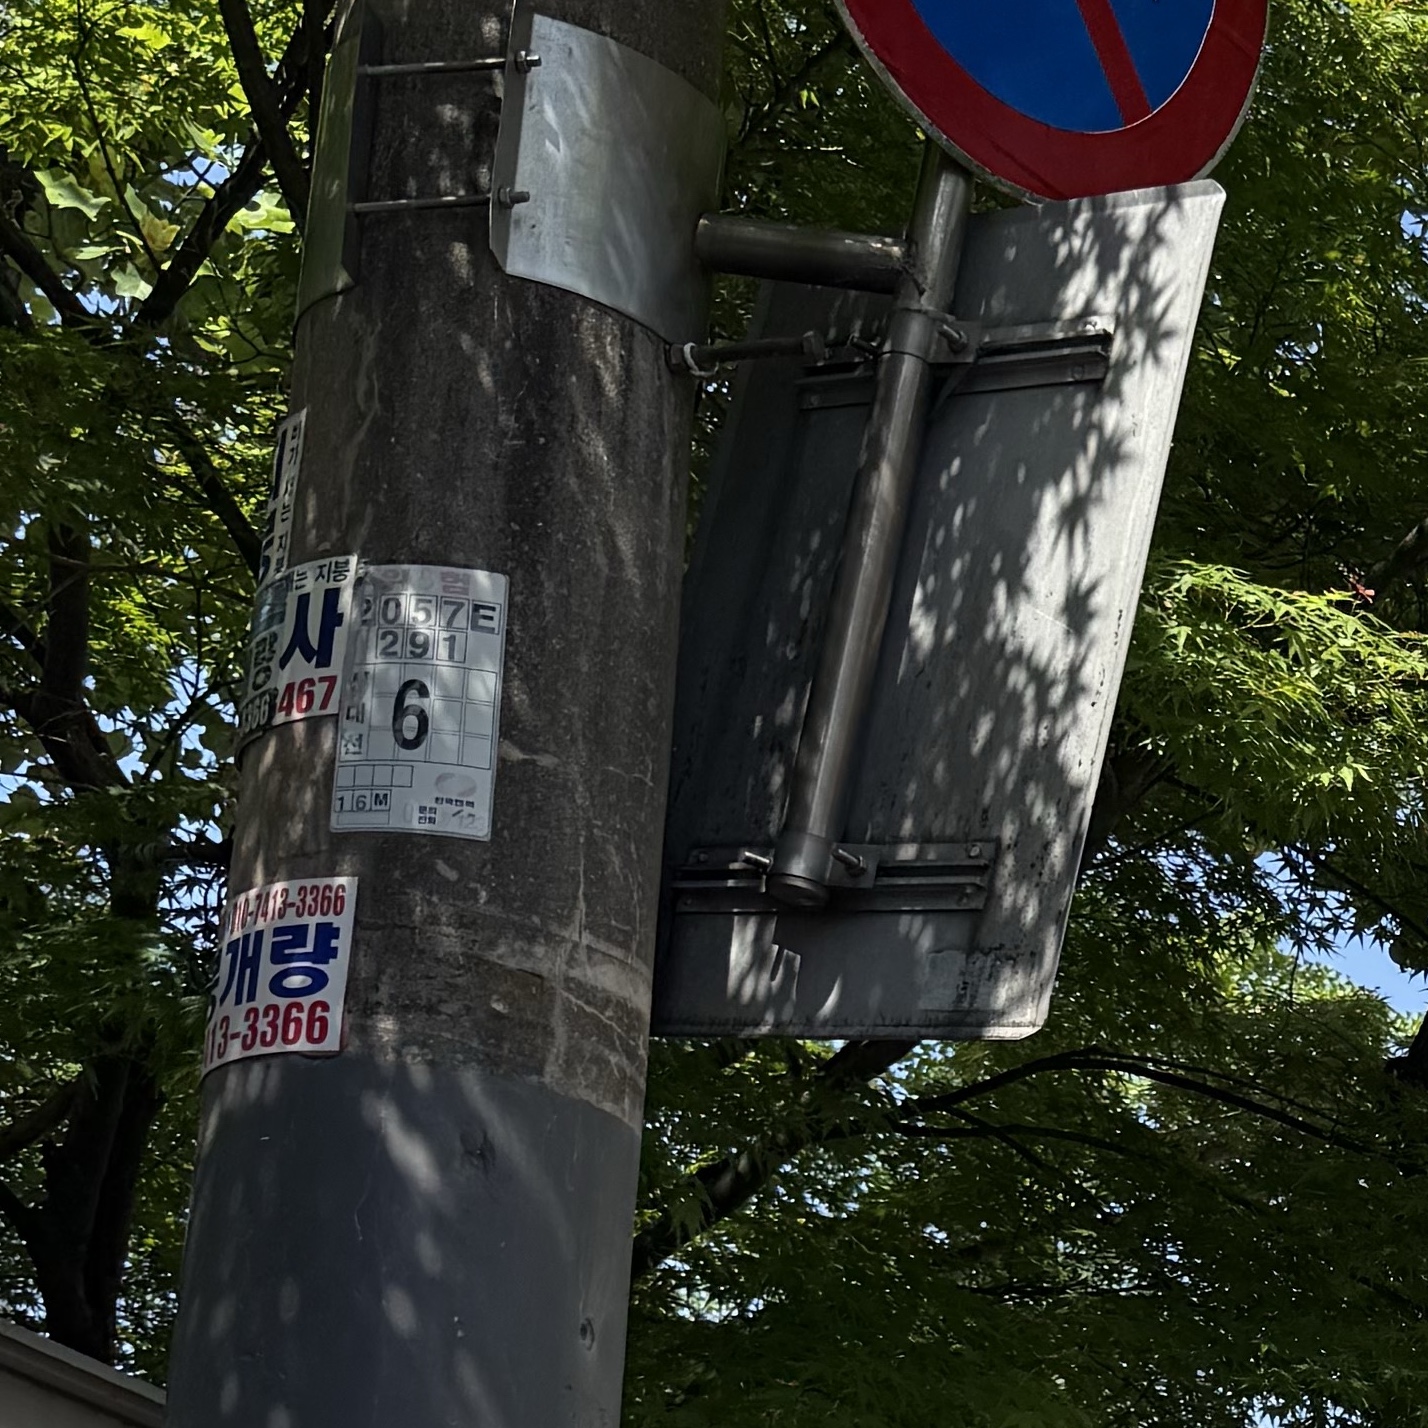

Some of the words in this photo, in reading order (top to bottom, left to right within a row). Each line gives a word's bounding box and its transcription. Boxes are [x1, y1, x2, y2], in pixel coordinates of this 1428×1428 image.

[314, 557, 350, 584] 지붕
[279, 587, 344, 672] 사
[379, 629, 458, 662] 291
[278, 675, 338, 717] 467
[392, 678, 431, 751] 6
[219, 921, 341, 1008] 개량
